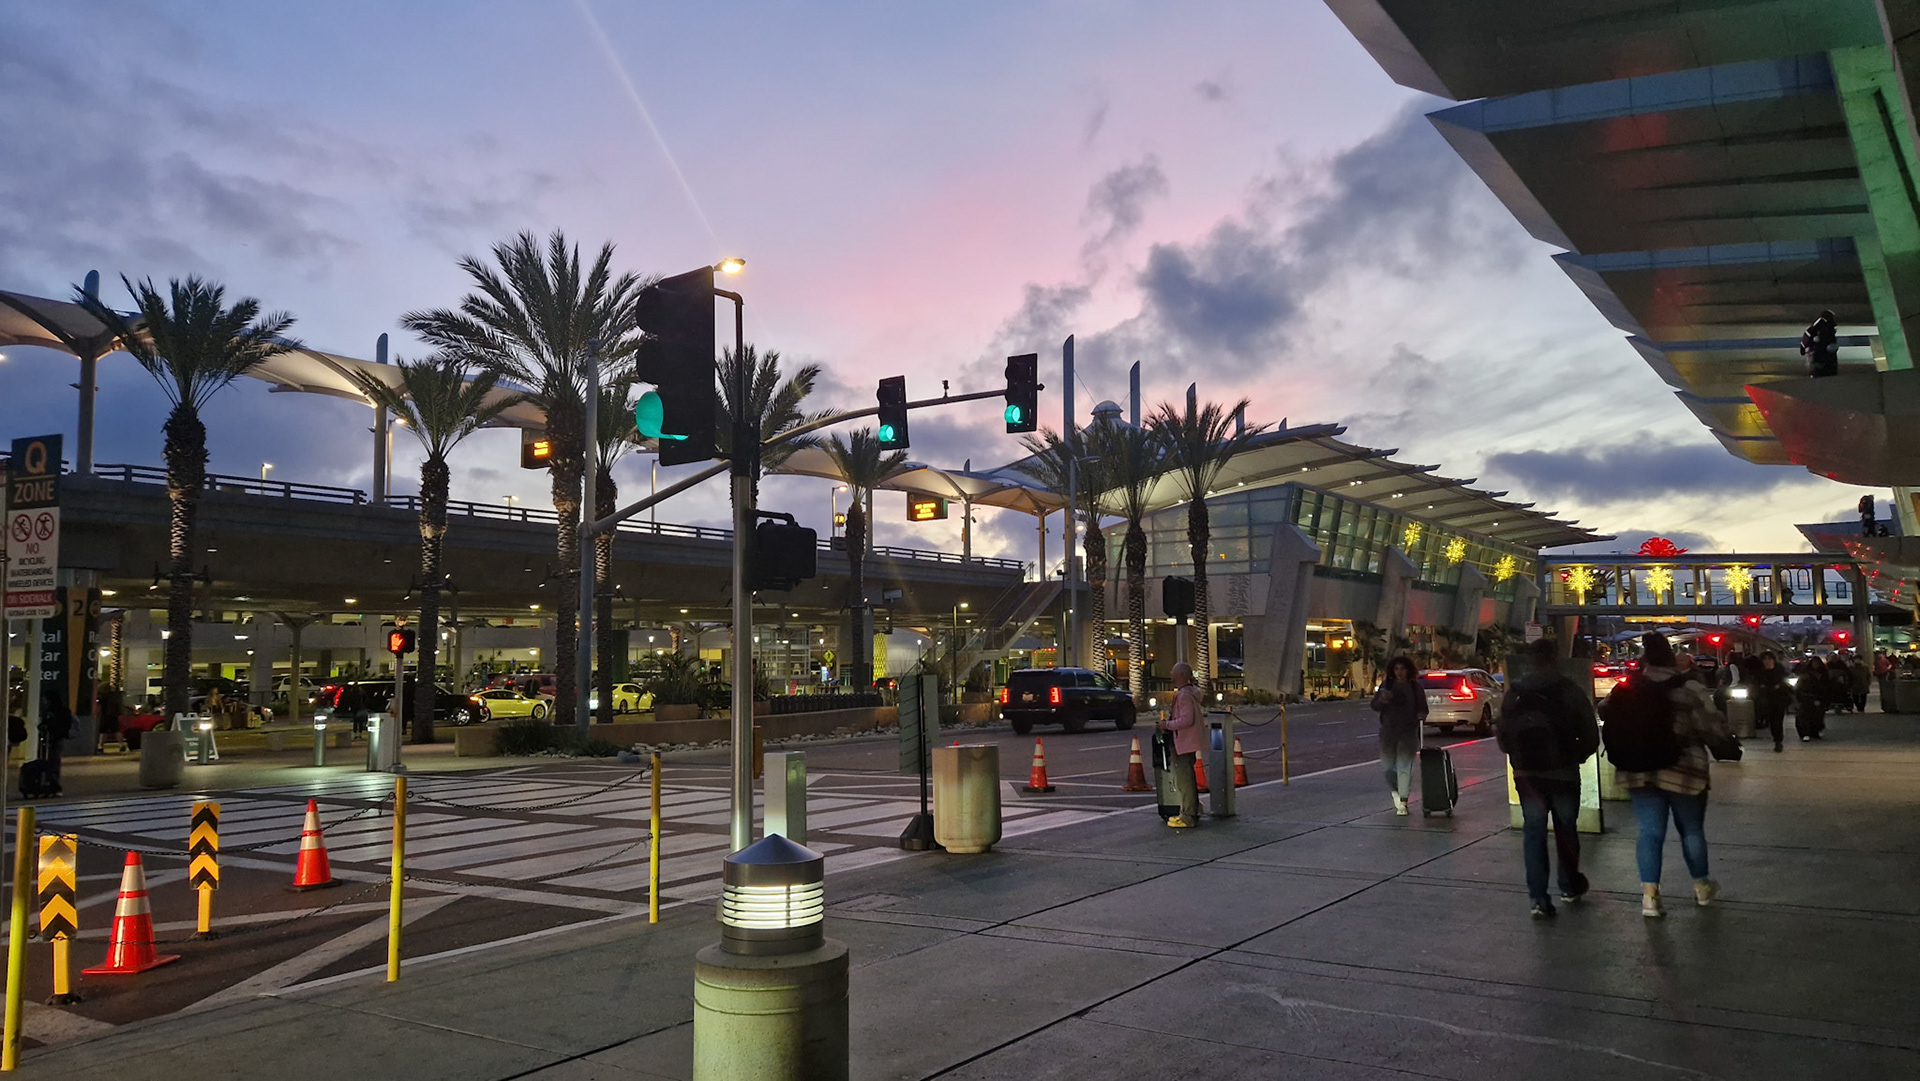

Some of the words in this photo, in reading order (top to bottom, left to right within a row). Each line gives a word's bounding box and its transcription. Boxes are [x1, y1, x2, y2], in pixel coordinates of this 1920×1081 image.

[25, 441, 47, 474] Q
[13, 481, 55, 504] ZONE
[26, 542, 39, 554] NO
[19, 593, 53, 604] SIDEWALK
[73, 600, 83, 616] 2
